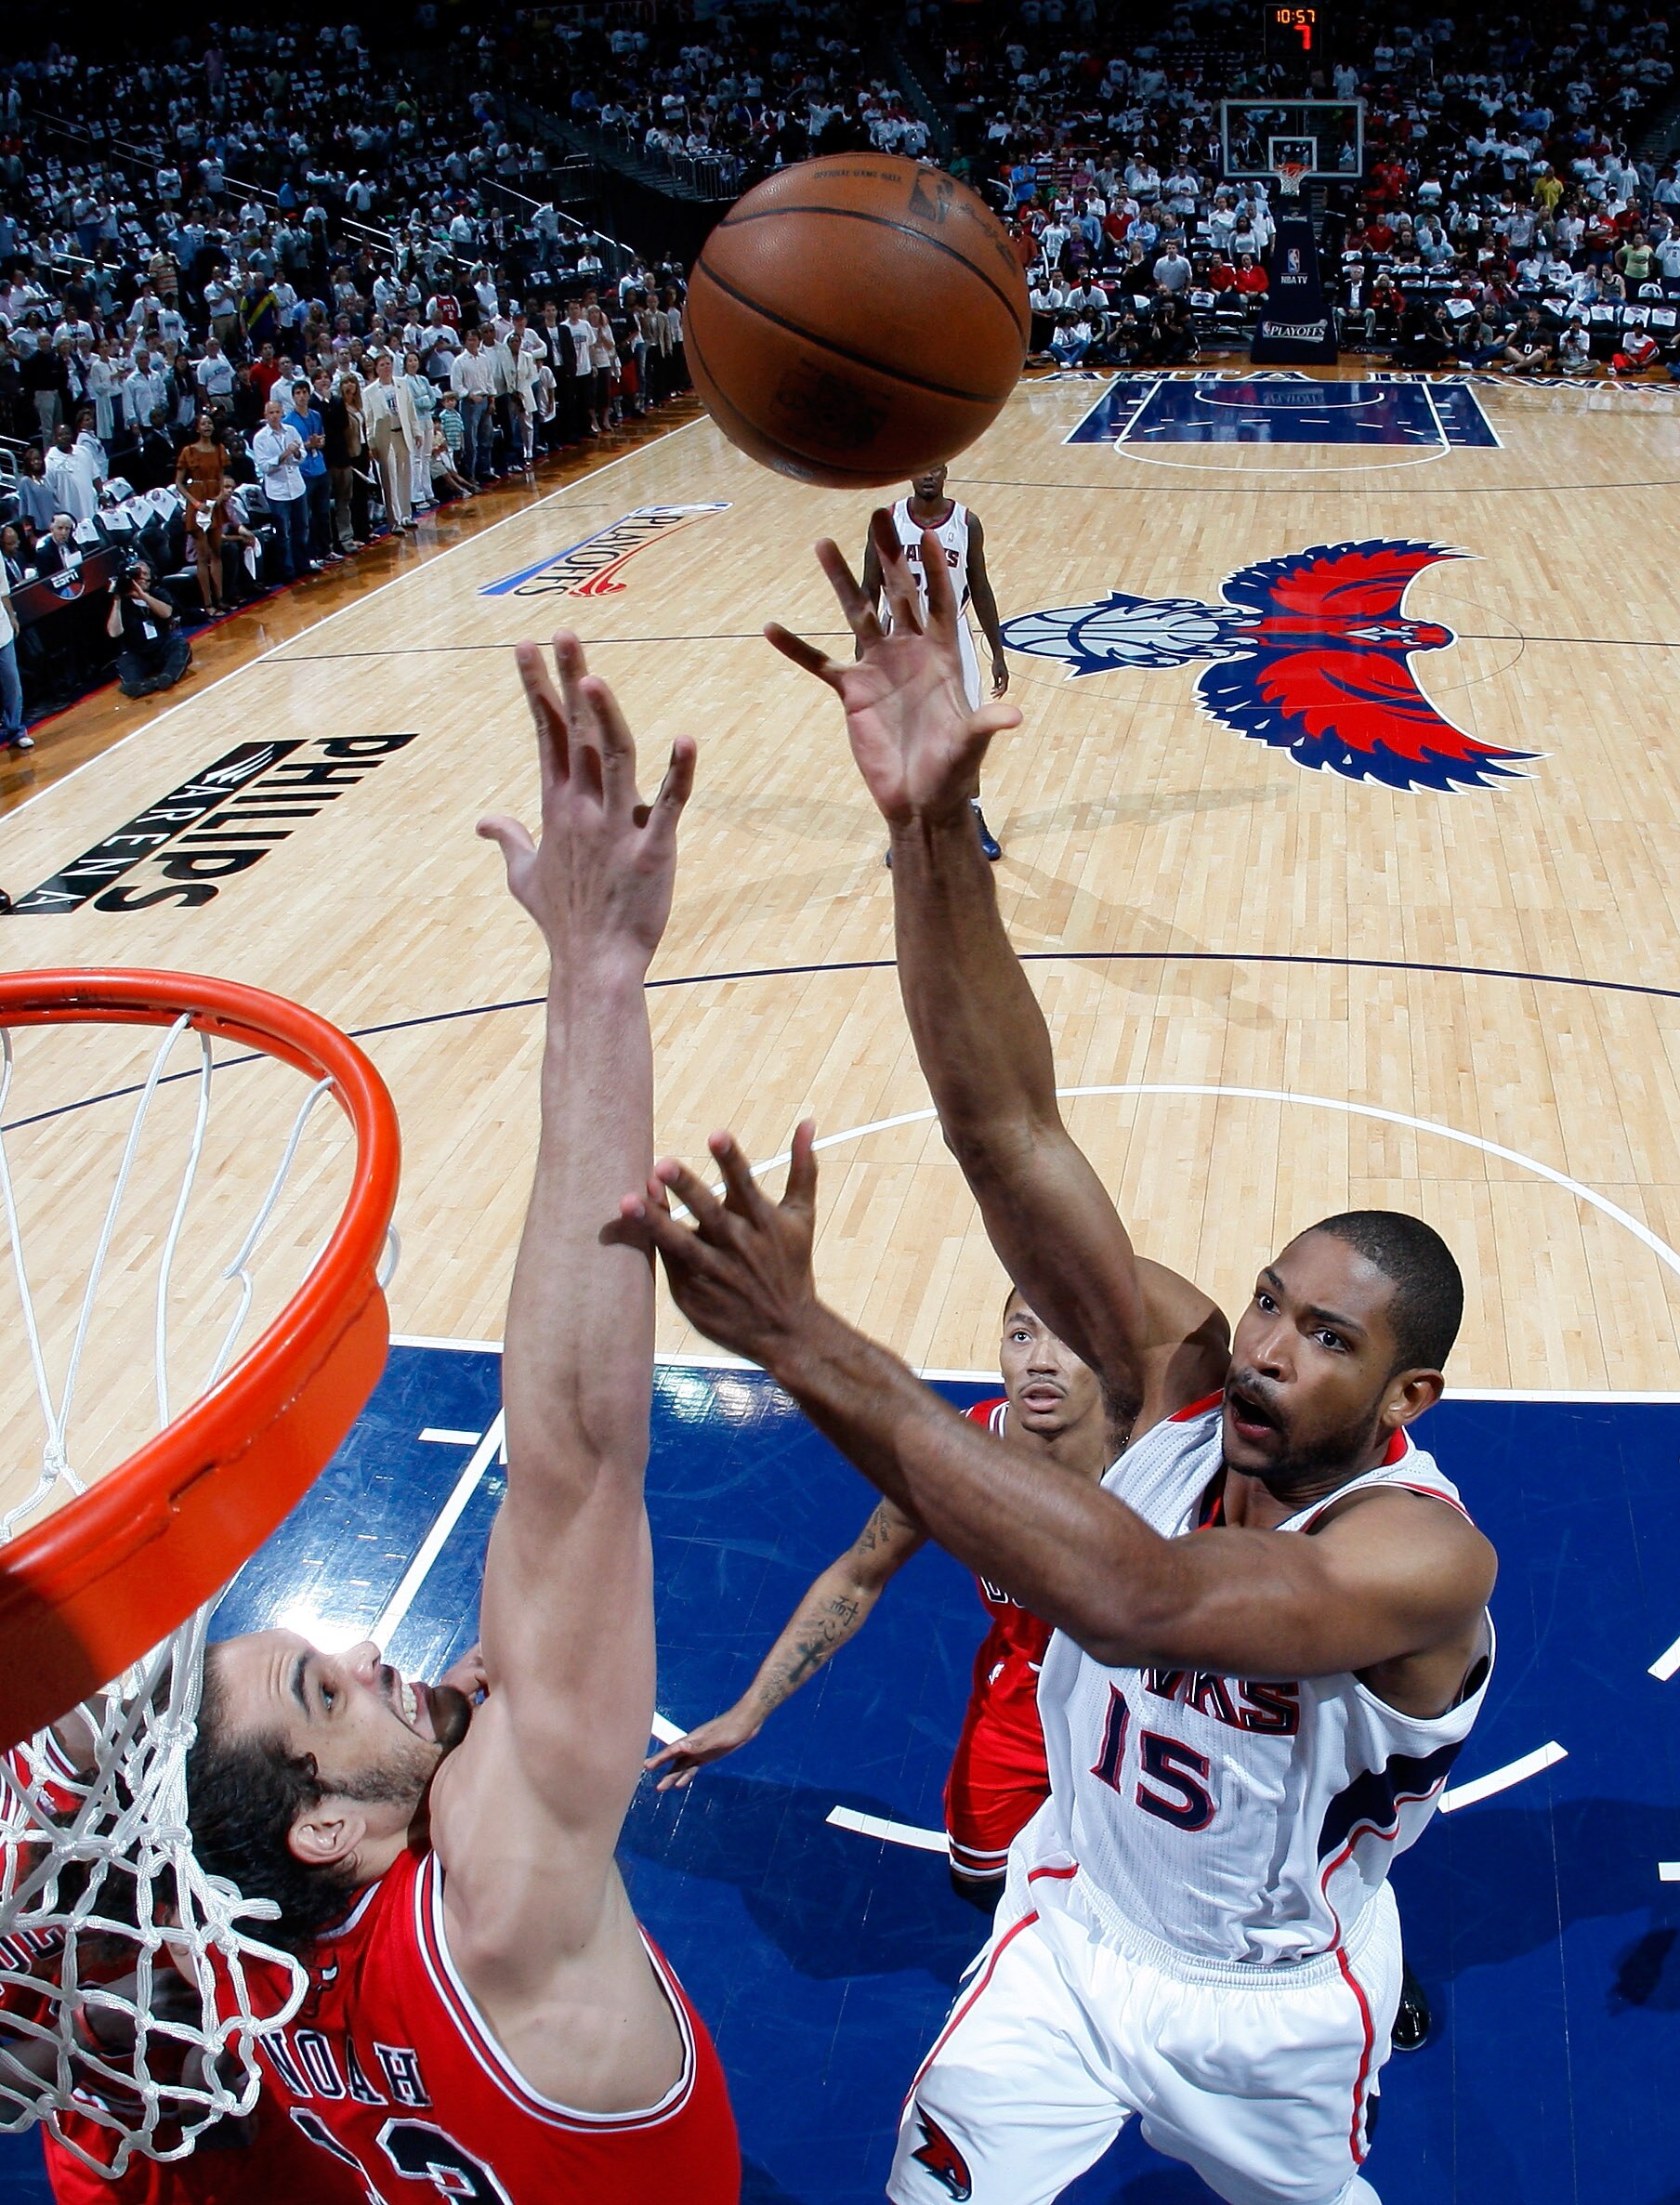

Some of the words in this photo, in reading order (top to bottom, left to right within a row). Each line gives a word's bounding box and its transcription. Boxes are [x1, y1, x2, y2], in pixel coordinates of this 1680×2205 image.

[1277, 9, 1316, 24] 10:57
[1293, 24, 1311, 50] 7
[1269, 325, 1326, 336] PLAYOFFS
[1367, 372, 1680, 394] HAWK
[513, 515, 685, 596] PLAYOFFS
[16, 783, 235, 910] ARENA
[93, 733, 421, 913] PHILIPS
[1090, 1680, 1217, 1833] 15
[258, 2028, 434, 2108] NOAH
